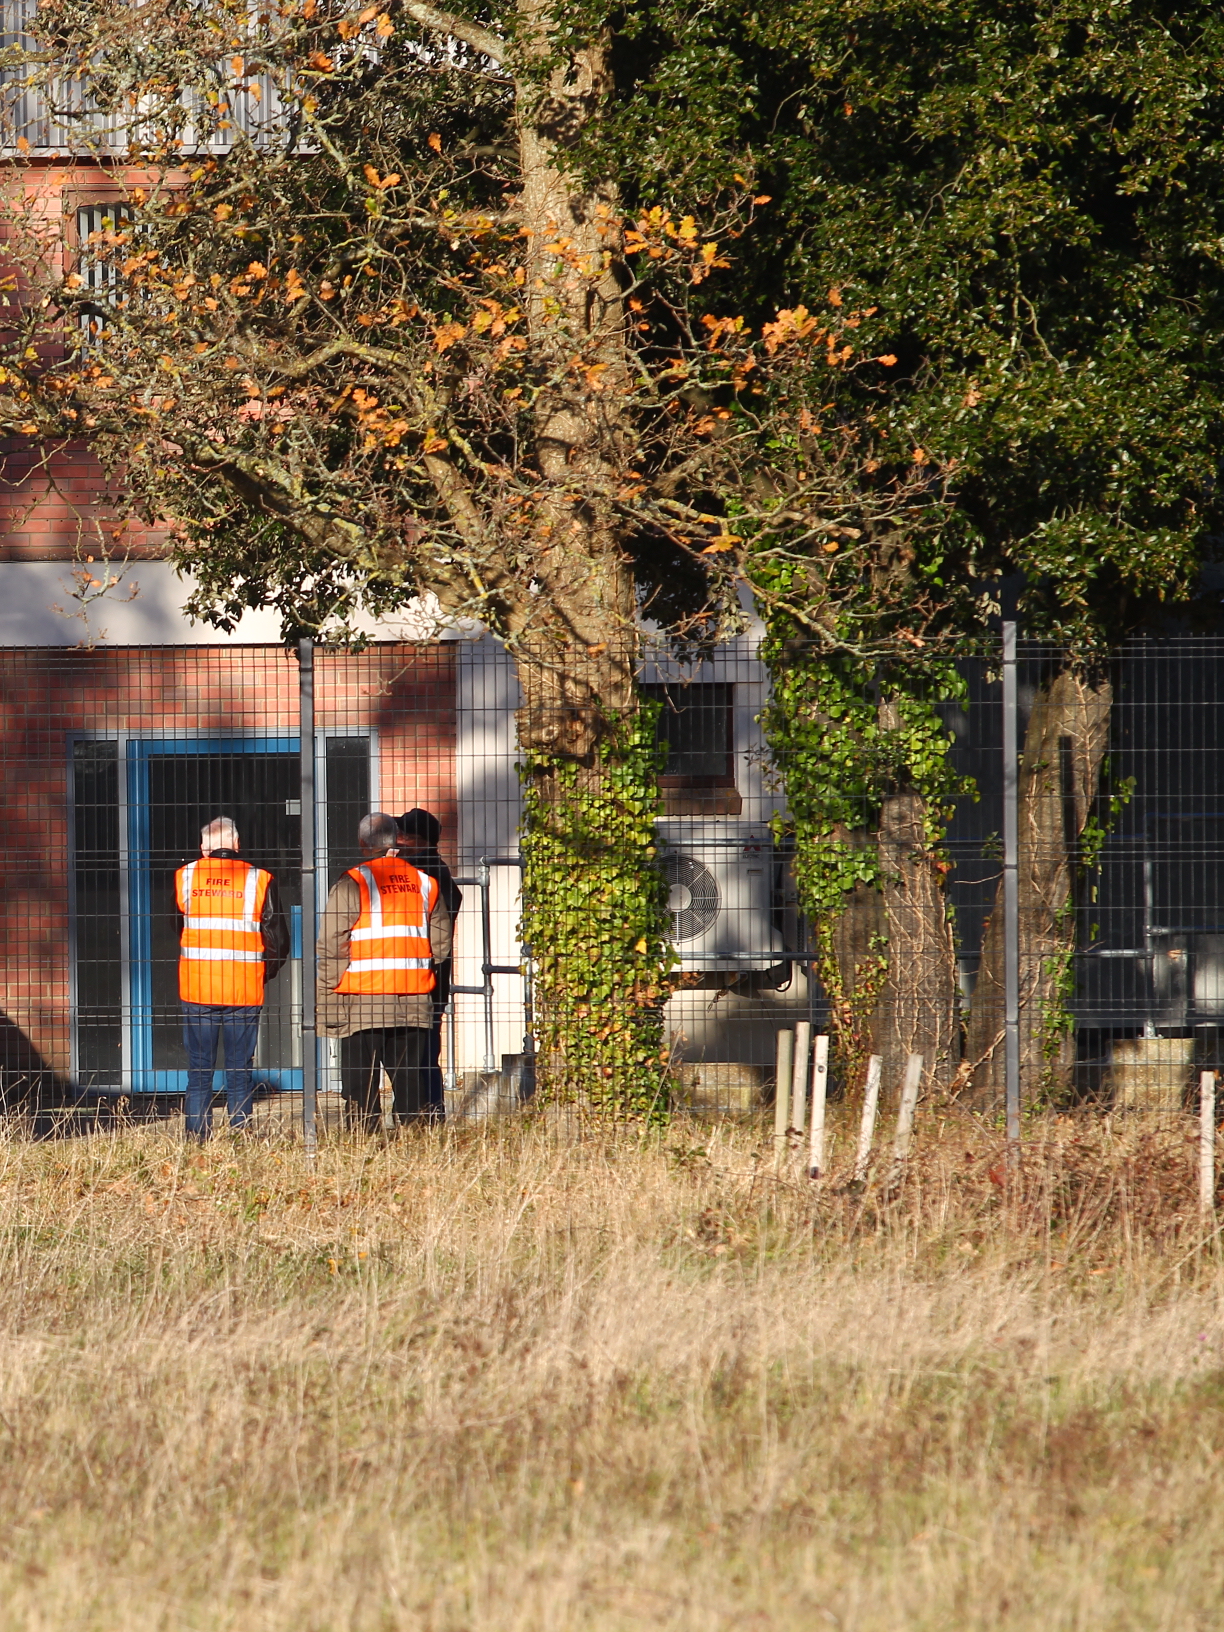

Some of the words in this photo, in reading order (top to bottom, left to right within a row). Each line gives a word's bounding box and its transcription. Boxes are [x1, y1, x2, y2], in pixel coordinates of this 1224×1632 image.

[206, 878, 231, 886] FIRE
[389, 875, 411, 883] FIRE
[192, 889, 243, 898] STEWARD
